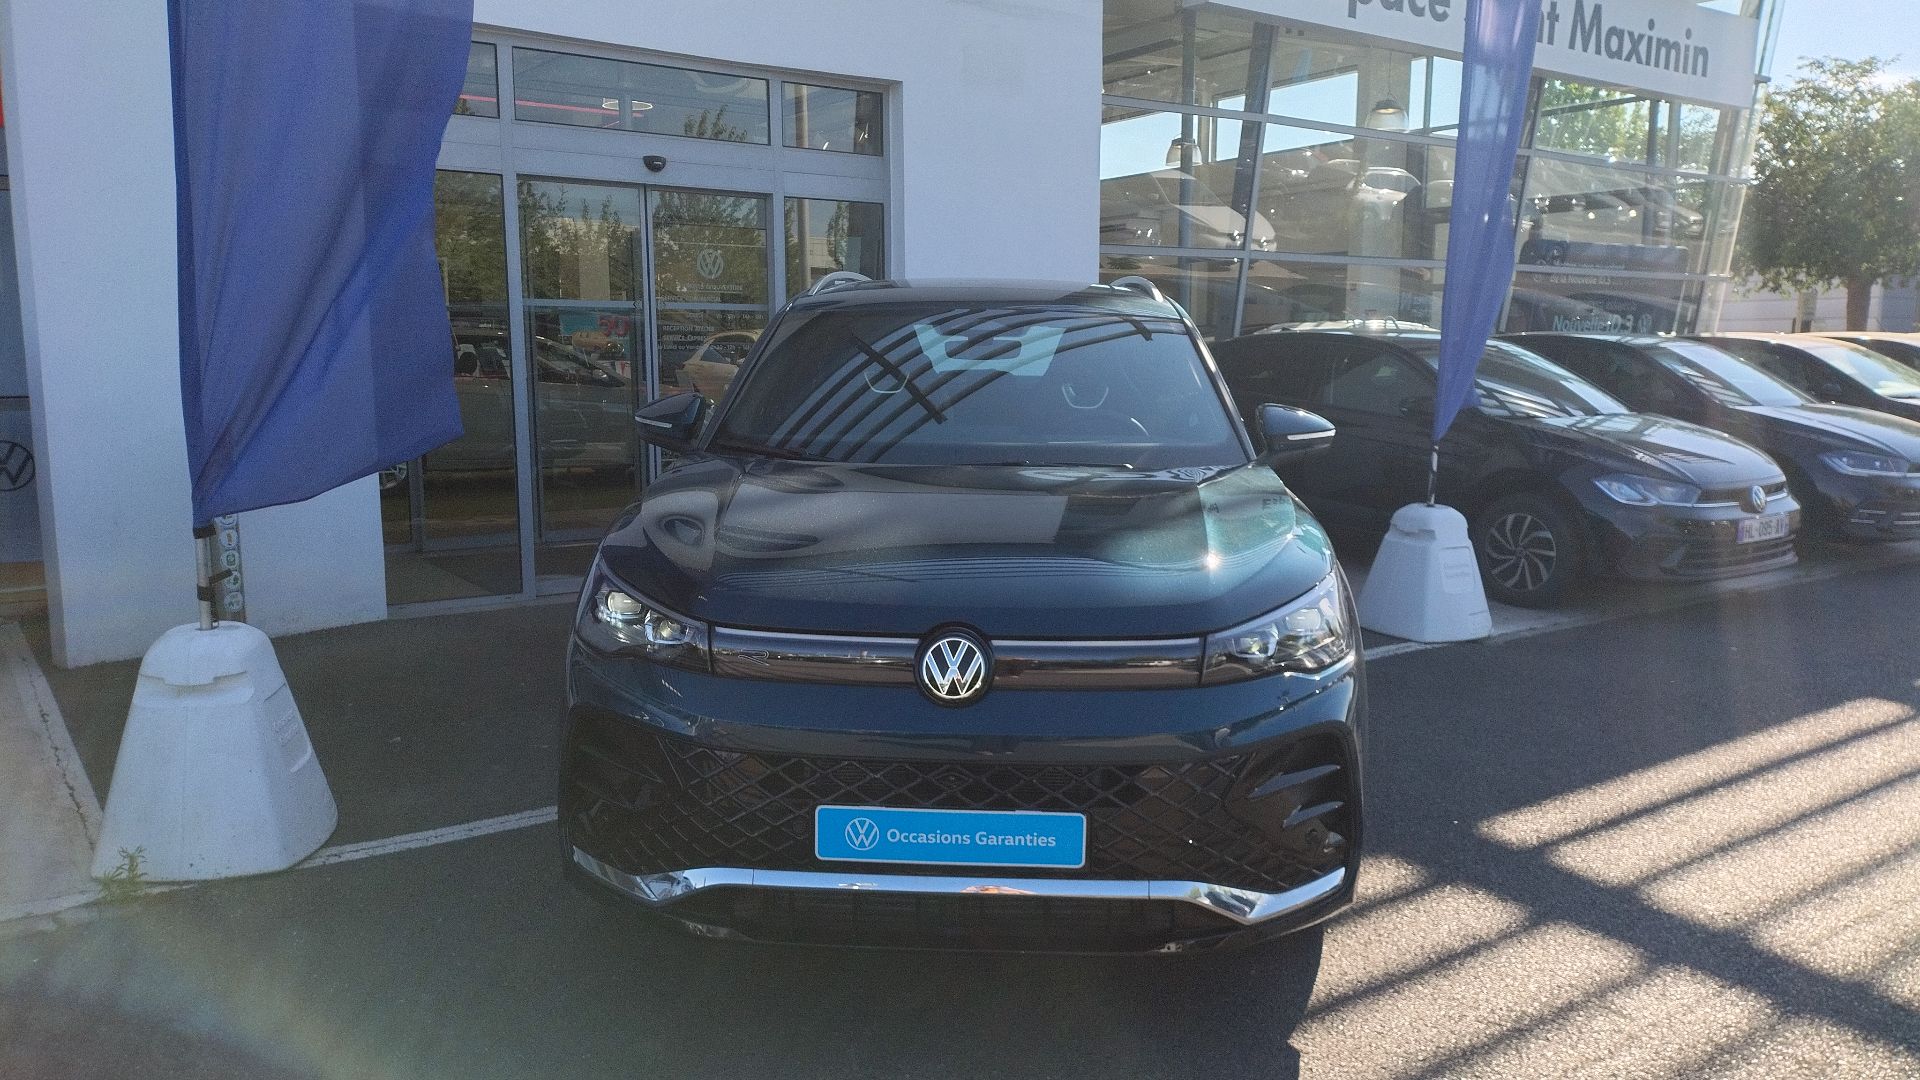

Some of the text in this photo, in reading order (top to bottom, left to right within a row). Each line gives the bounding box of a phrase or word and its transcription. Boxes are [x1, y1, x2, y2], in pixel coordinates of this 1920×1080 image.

[1569, 0, 1710, 78] Maximin
[886, 828, 970, 845] Occasions
[975, 831, 1056, 847] Garanties
